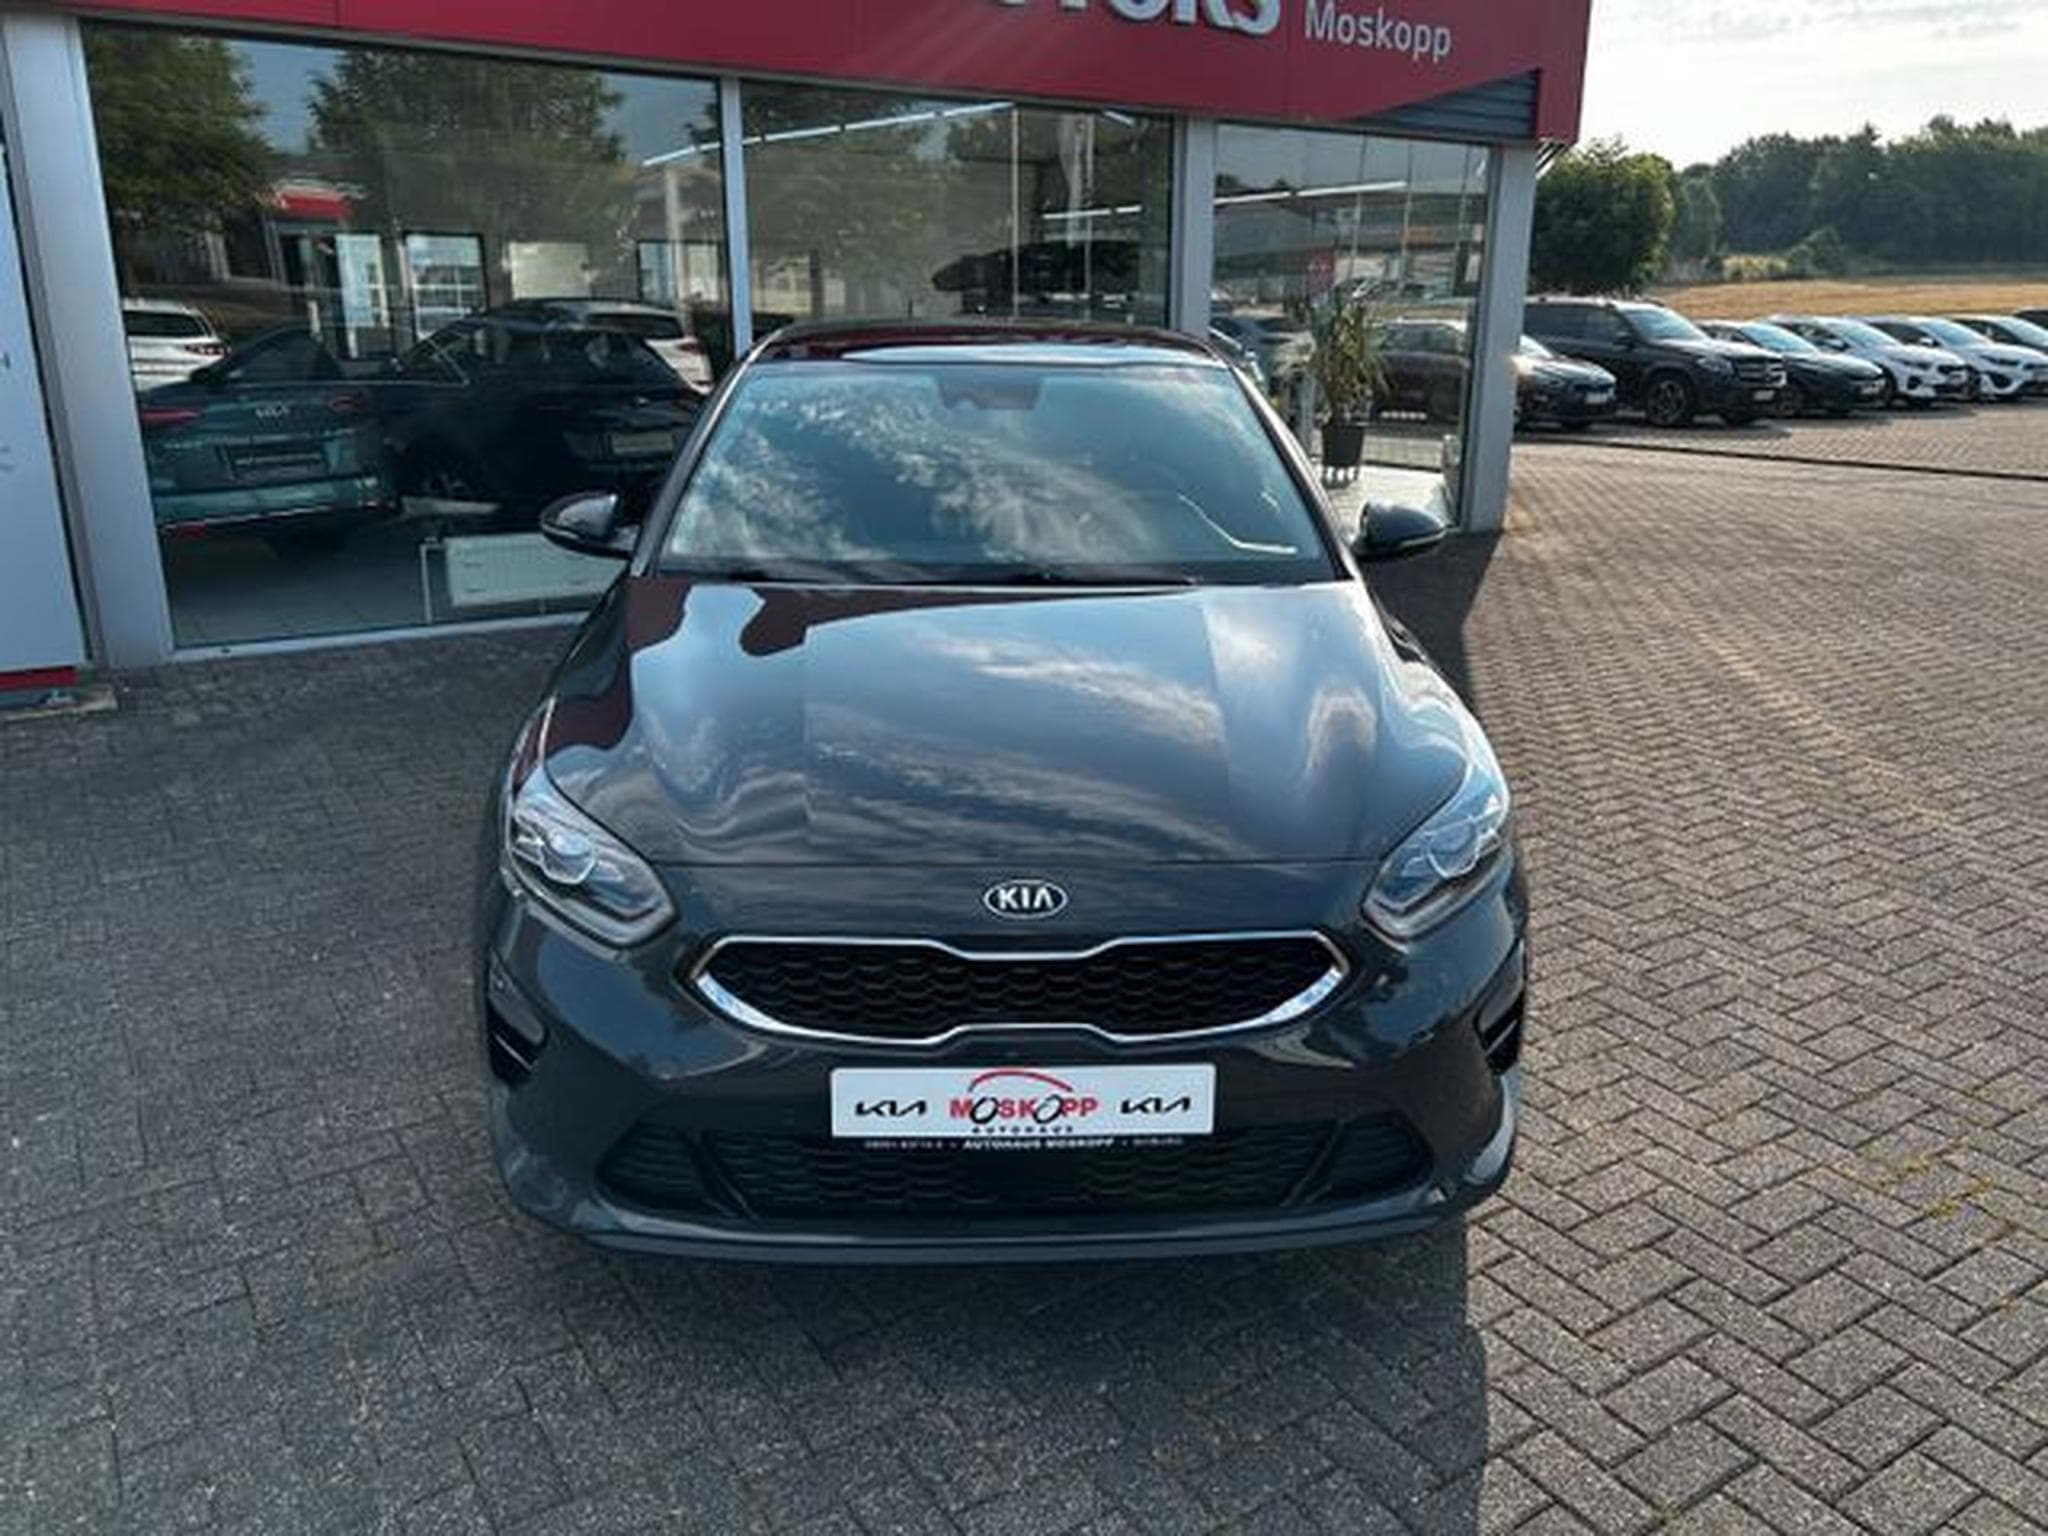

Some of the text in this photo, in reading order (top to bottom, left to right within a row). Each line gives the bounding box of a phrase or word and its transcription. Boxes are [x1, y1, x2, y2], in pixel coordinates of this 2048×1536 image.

[1304, 0, 1451, 63] Moskopp
[855, 1100, 927, 1117] KIA
[949, 1094, 1099, 1125] MOSKOPP
[1121, 1097, 1192, 1114] KIA
[962, 1138, 1042, 1151] AUTOHAUS
